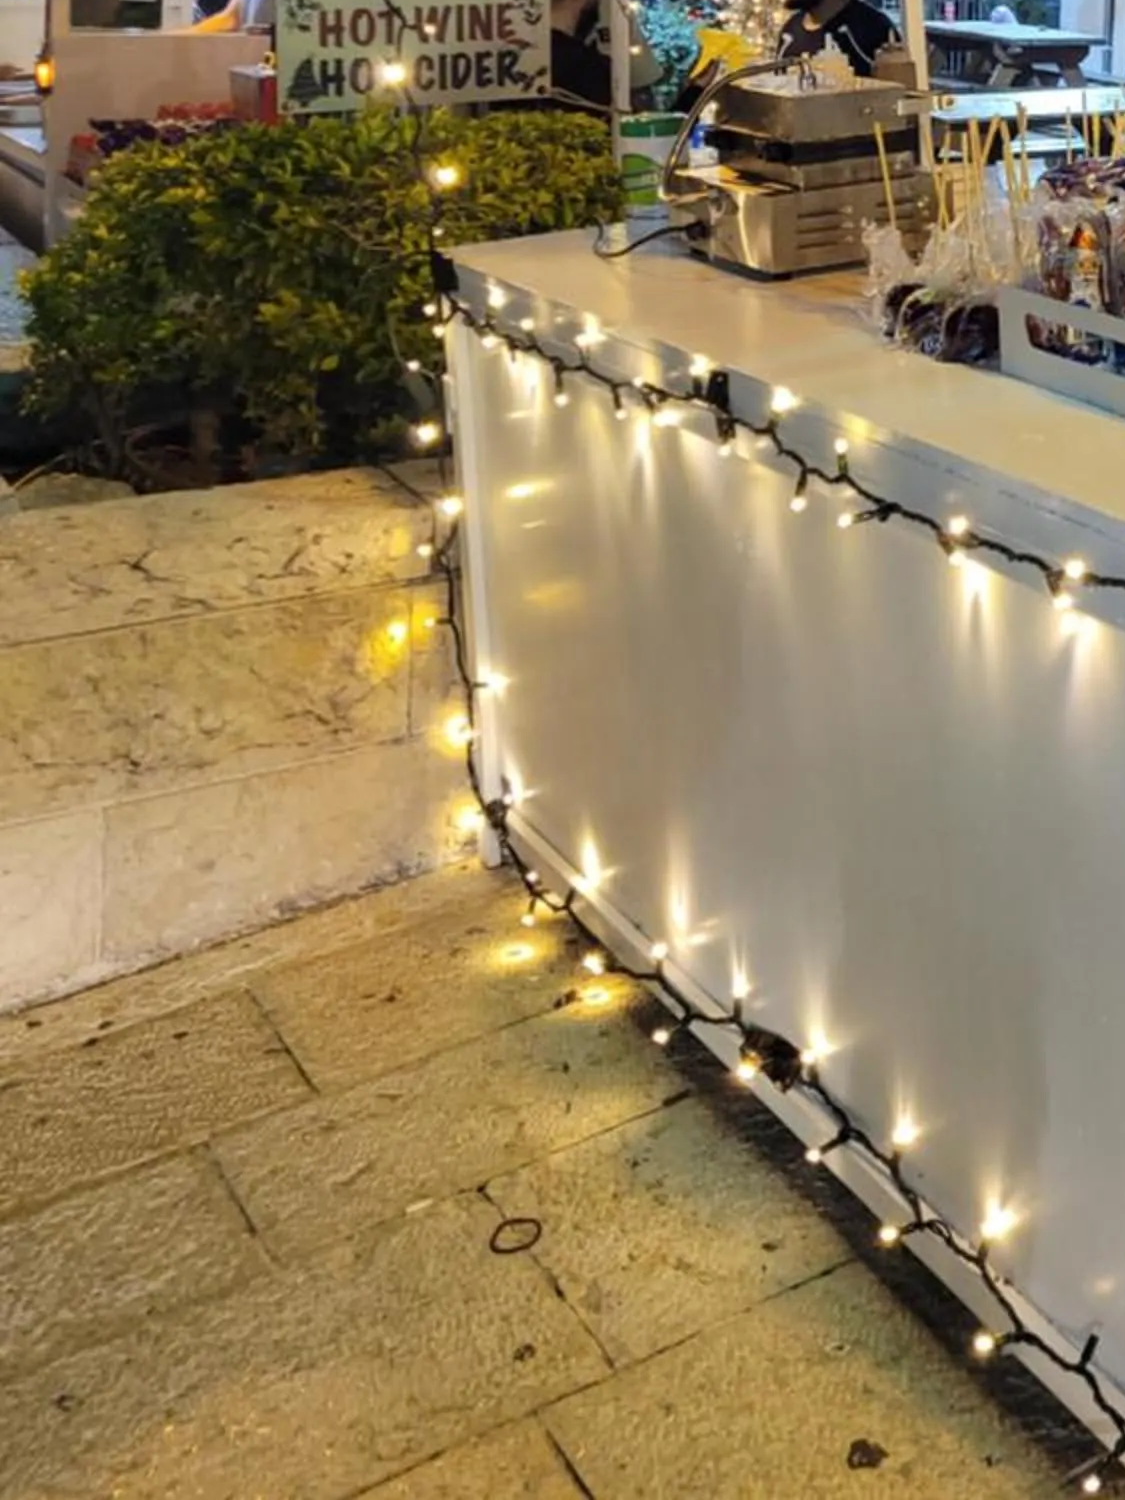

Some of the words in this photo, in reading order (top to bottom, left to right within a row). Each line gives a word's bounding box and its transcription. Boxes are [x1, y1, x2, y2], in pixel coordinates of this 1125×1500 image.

[318, 6, 400, 48] HOT
[414, 2, 519, 44] WINE
[319, 56, 401, 97] HO
[413, 49, 521, 92] CIDER
